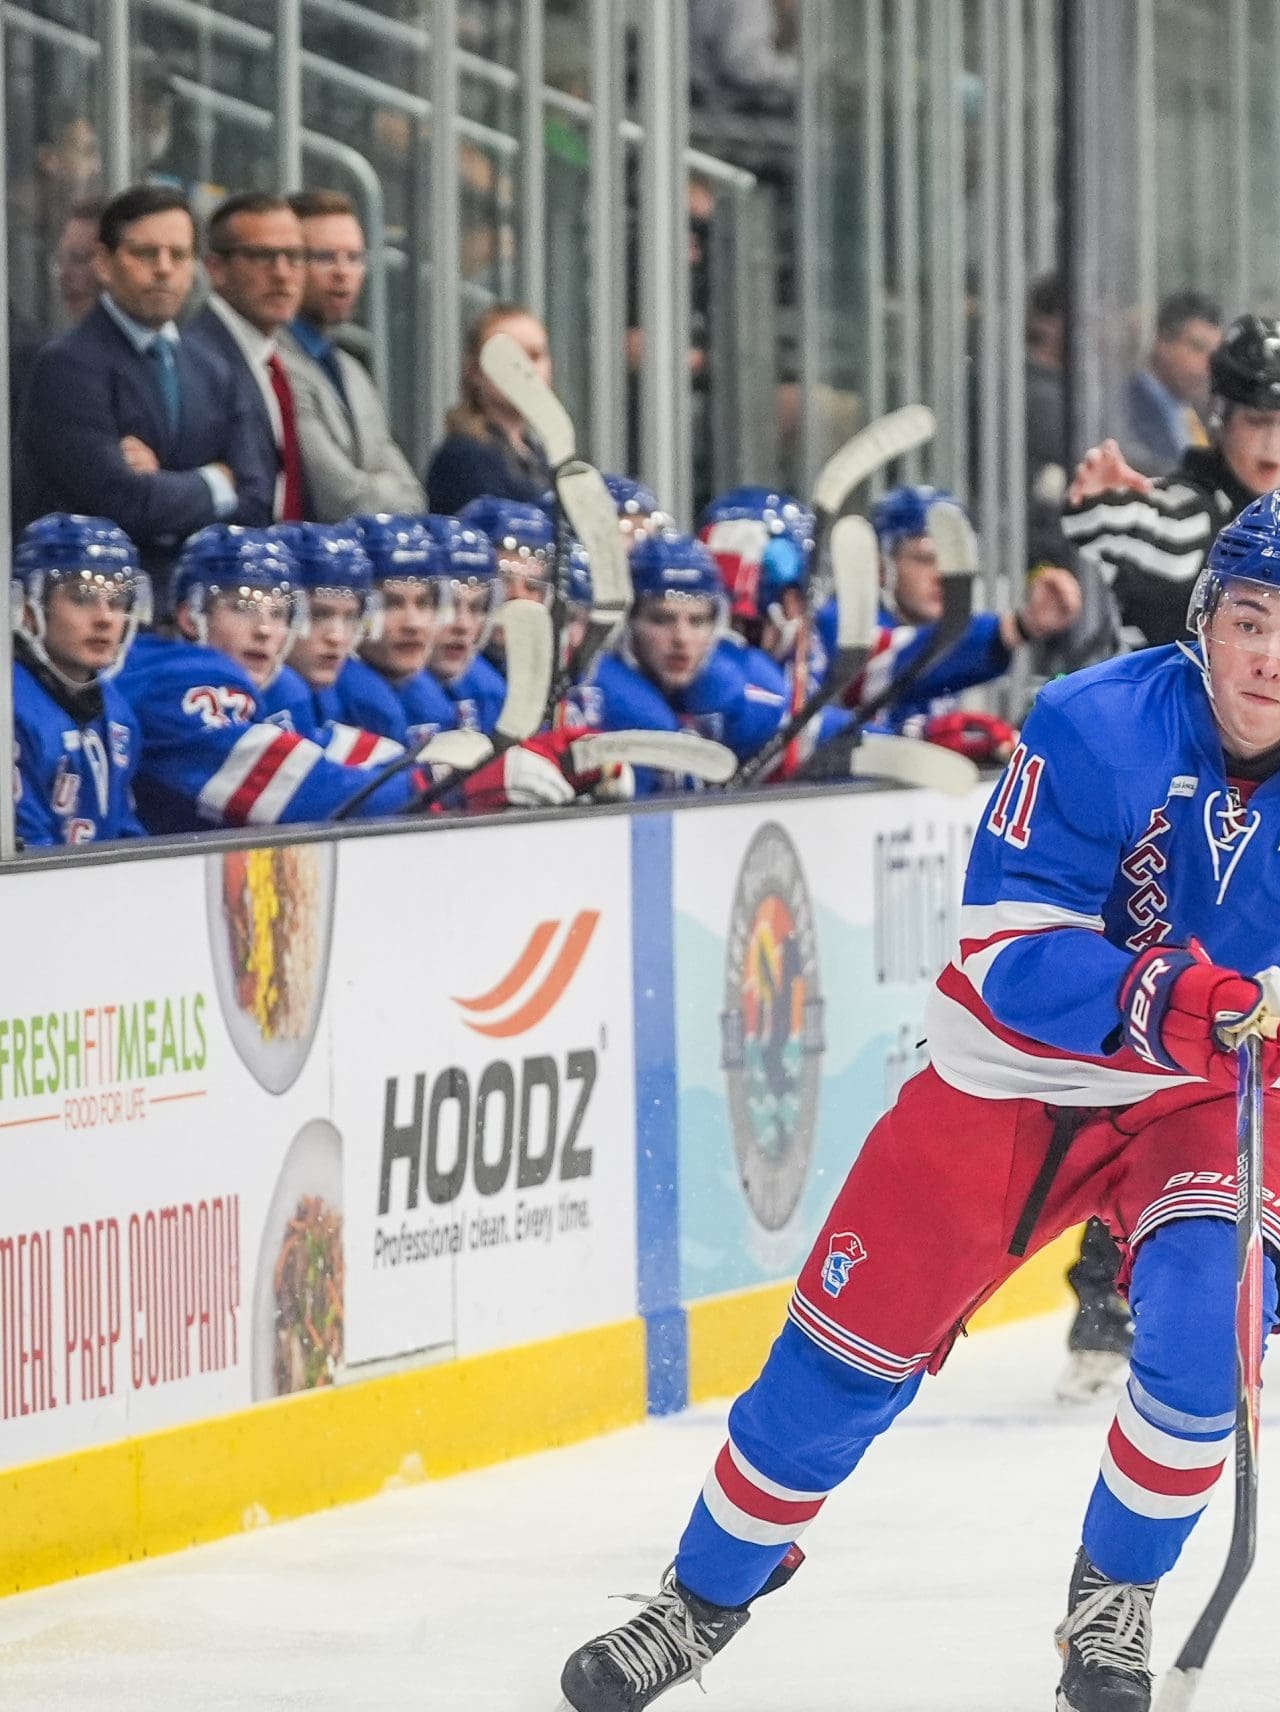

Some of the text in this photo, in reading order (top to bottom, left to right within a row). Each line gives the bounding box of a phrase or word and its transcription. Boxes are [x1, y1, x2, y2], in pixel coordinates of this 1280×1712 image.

[987, 742, 1045, 850] 11
[64, 1086, 146, 1132] FOOD FOR LIFE
[376, 1046, 598, 1217] HOODZ
[372, 1192, 592, 1270] Professional clean. Every time.
[63, 1217, 121, 1406] PREP
[128, 1192, 240, 1391] COMPANY
